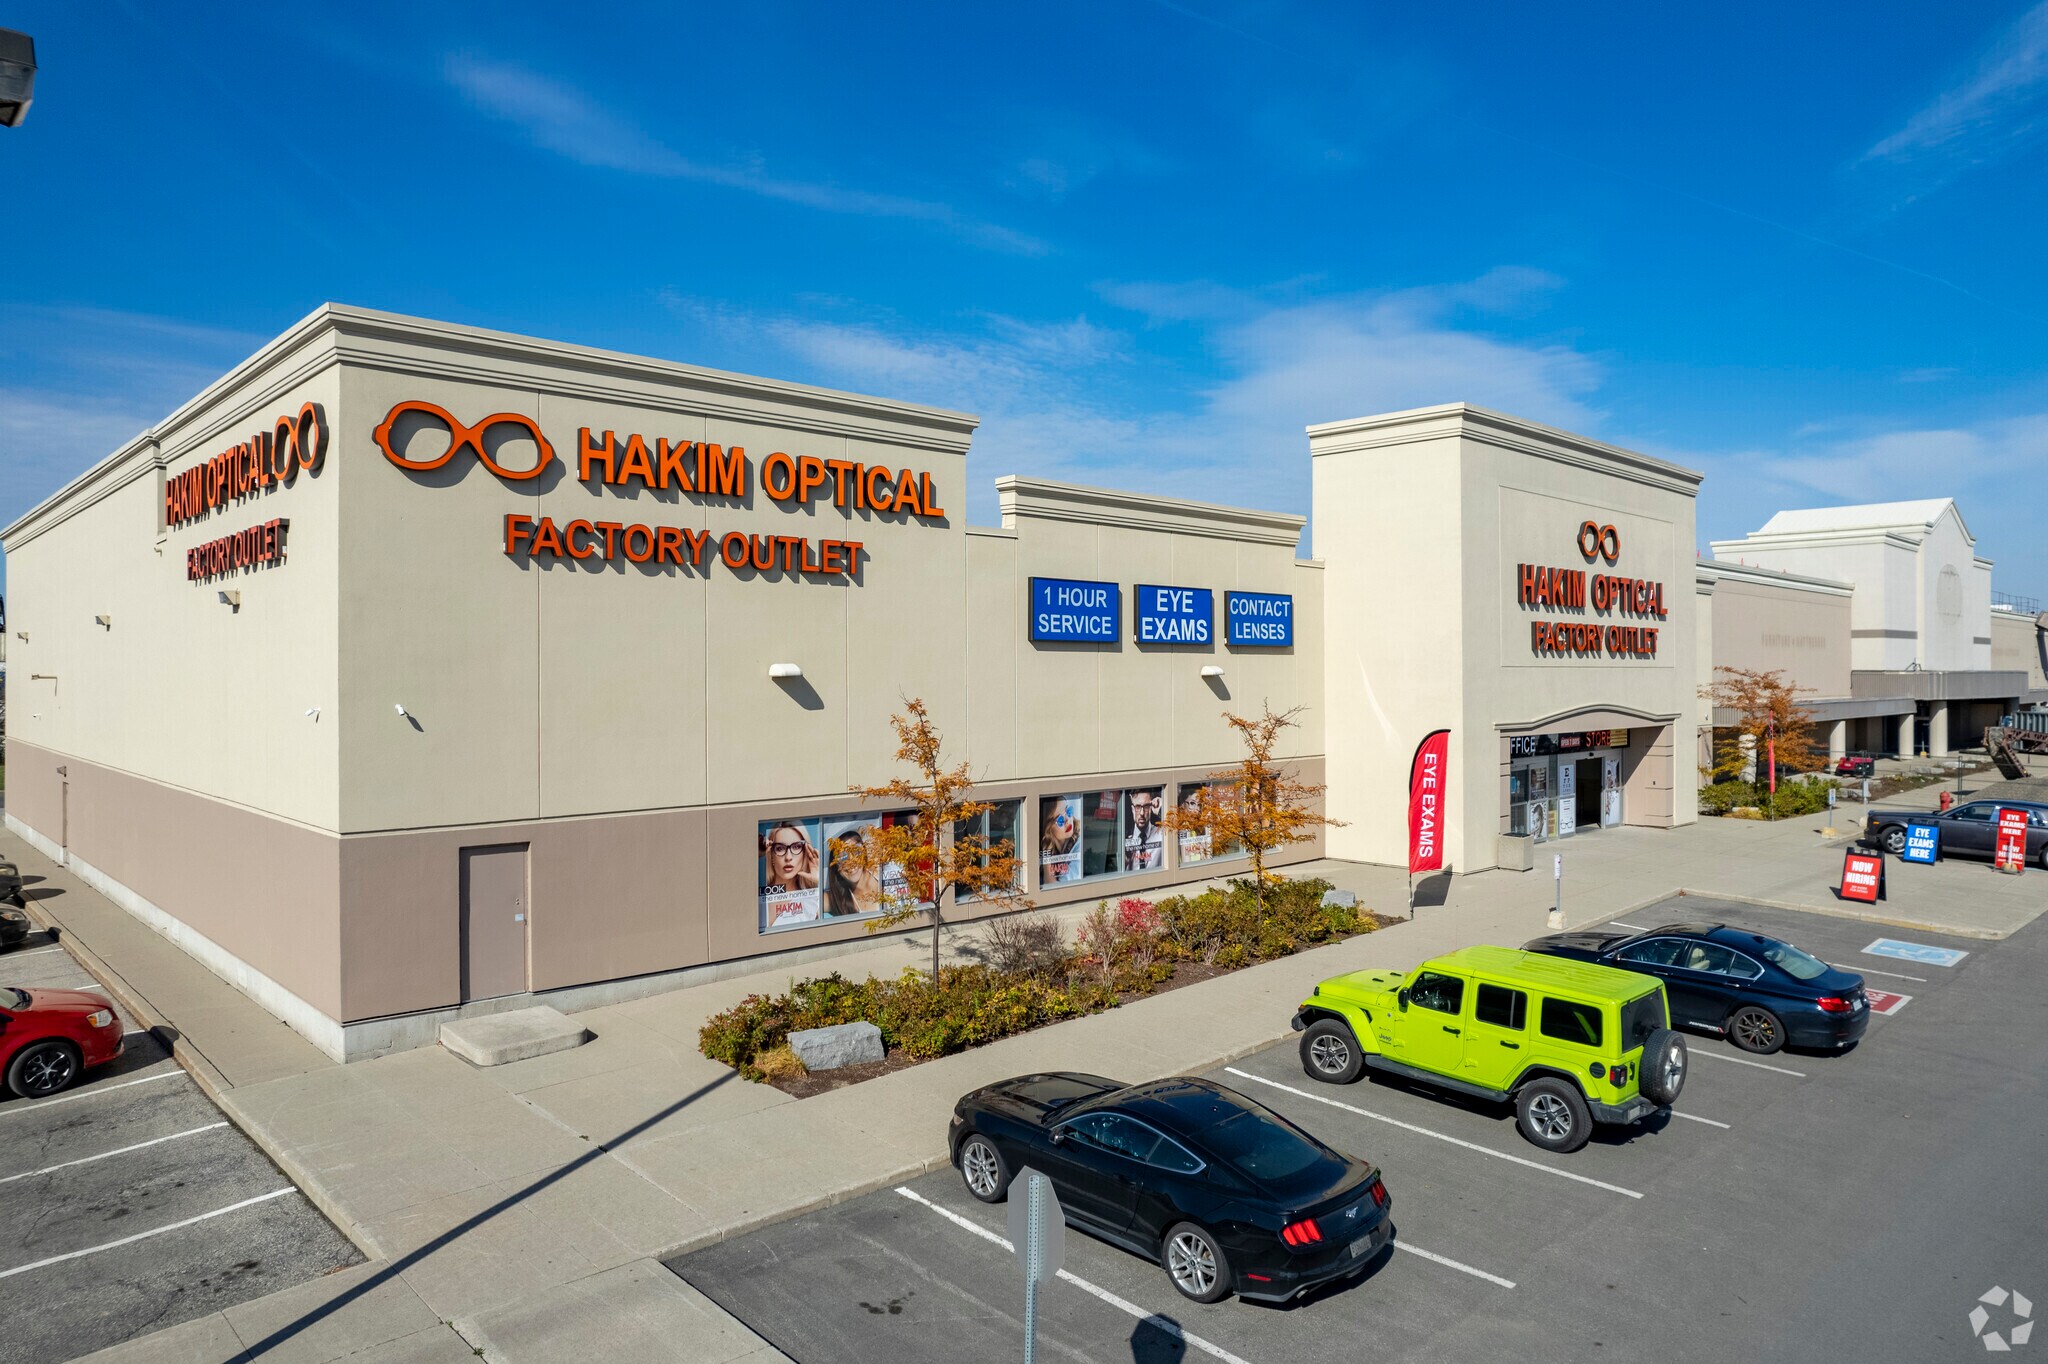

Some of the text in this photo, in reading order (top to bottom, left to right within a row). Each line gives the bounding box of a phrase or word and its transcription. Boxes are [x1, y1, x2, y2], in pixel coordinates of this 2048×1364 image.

[166, 431, 270, 526] HAKIM OPTICAL
[577, 426, 945, 518] HAKIM OPTICAL
[187, 518, 284, 581] FACTORY OUTLET
[503, 513, 864, 575] FACTORY OUTLET
[1043, 586, 1108, 608] 1 HOUR
[1519, 563, 1668, 615] HAKIM OPTICAL
[1156, 589, 1194, 613] EYE
[1229, 598, 1291, 617] CONTACT
[1038, 613, 1112, 635] SERVICE
[1141, 617, 1208, 641] EXAMS
[1235, 621, 1285, 640] LENSES
[1532, 621, 1659, 653] FACTORY OUTLET
[1510, 736, 1536, 754] FFICE
[1585, 730, 1611, 748] STORE
[1419, 753, 1437, 857] EYE EXAMS
[1915, 827, 1930, 838] EYE
[2000, 820, 2026, 829] EXAMS
[1908, 837, 1934, 849] EXAMS
[2002, 845, 2020, 853] NW
[1910, 847, 1930, 859] HERE
[1998, 851, 2023, 860] HIING
[1852, 860, 1874, 873] NOW
[1846, 872, 1876, 886] HIRING
[760, 885, 785, 895] LOOK
[776, 902, 803, 913] HAKIM
